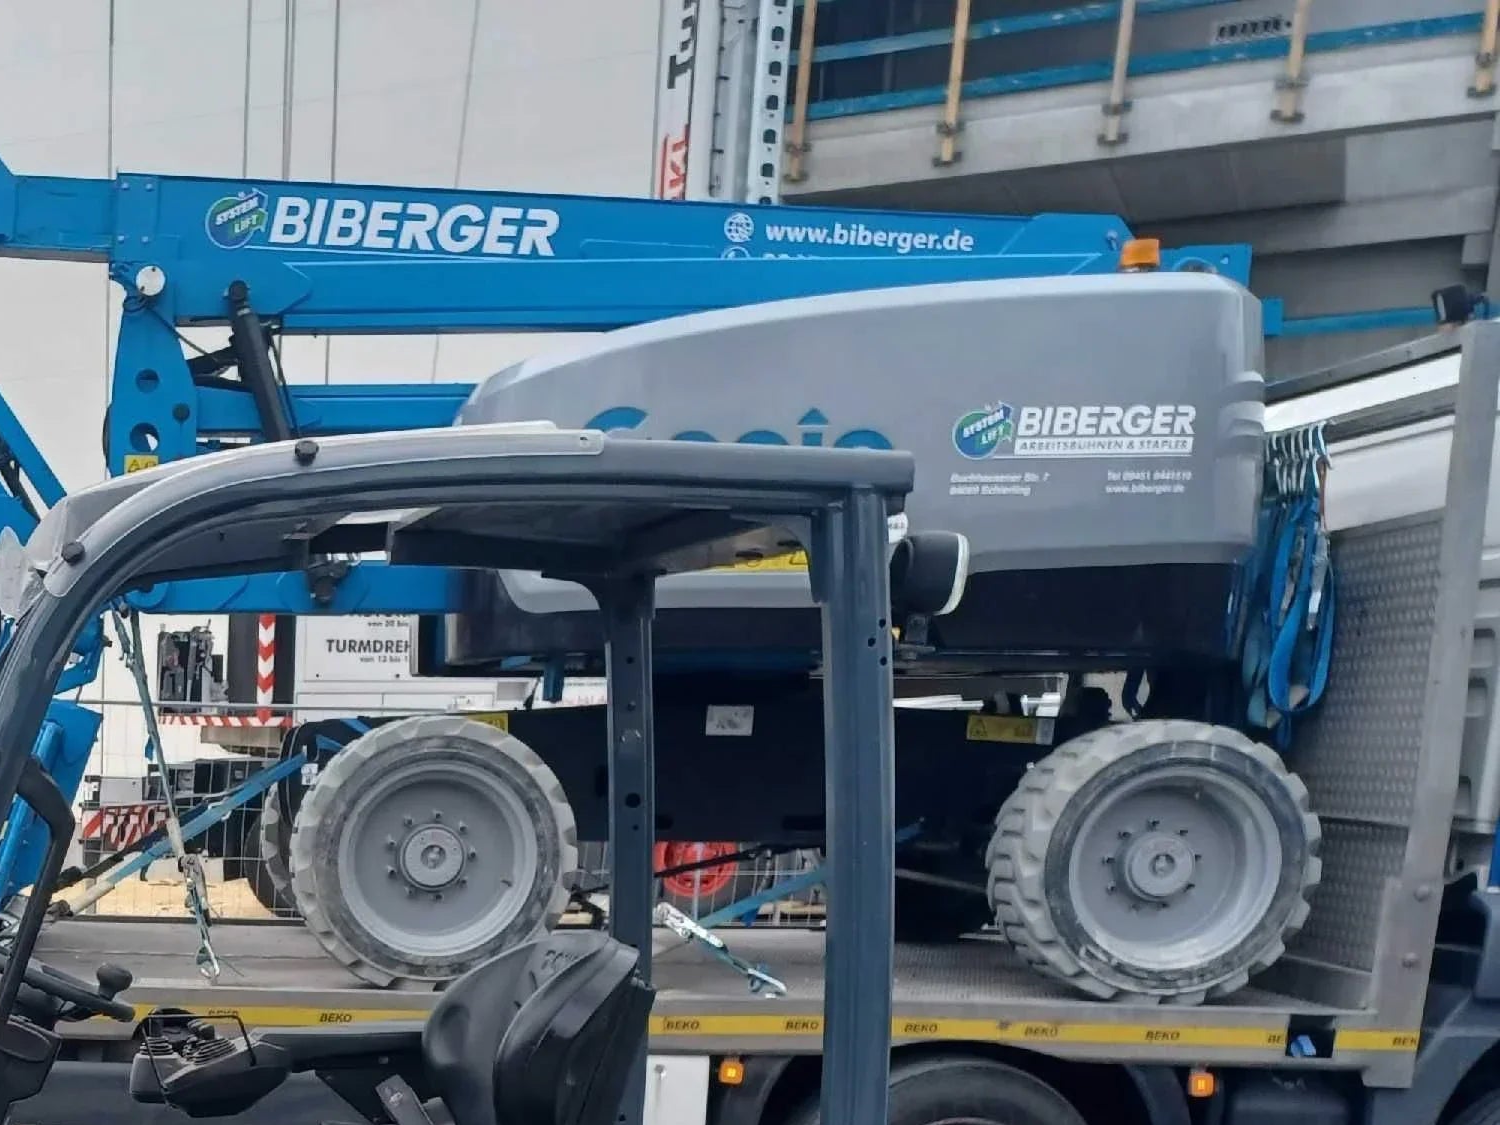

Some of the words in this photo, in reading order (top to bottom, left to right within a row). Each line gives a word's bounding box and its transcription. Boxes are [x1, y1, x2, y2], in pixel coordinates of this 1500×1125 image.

[214, 196, 260, 226] SYSTEM
[234, 214, 258, 233] LIFT
[268, 196, 561, 256] BIBERGER
[765, 222, 975, 253] www.biberger.de
[1017, 405, 1197, 436] BIBERGER
[1126, 439, 1136, 450] &
[319, 1013, 352, 1023] BEKO
[665, 1020, 700, 1030] BEKO
[784, 1020, 819, 1030] BEKO
[903, 1022, 939, 1033] BEKO
[1024, 1026, 1059, 1037] BEKO
[1145, 1030, 1180, 1041] BEKO
